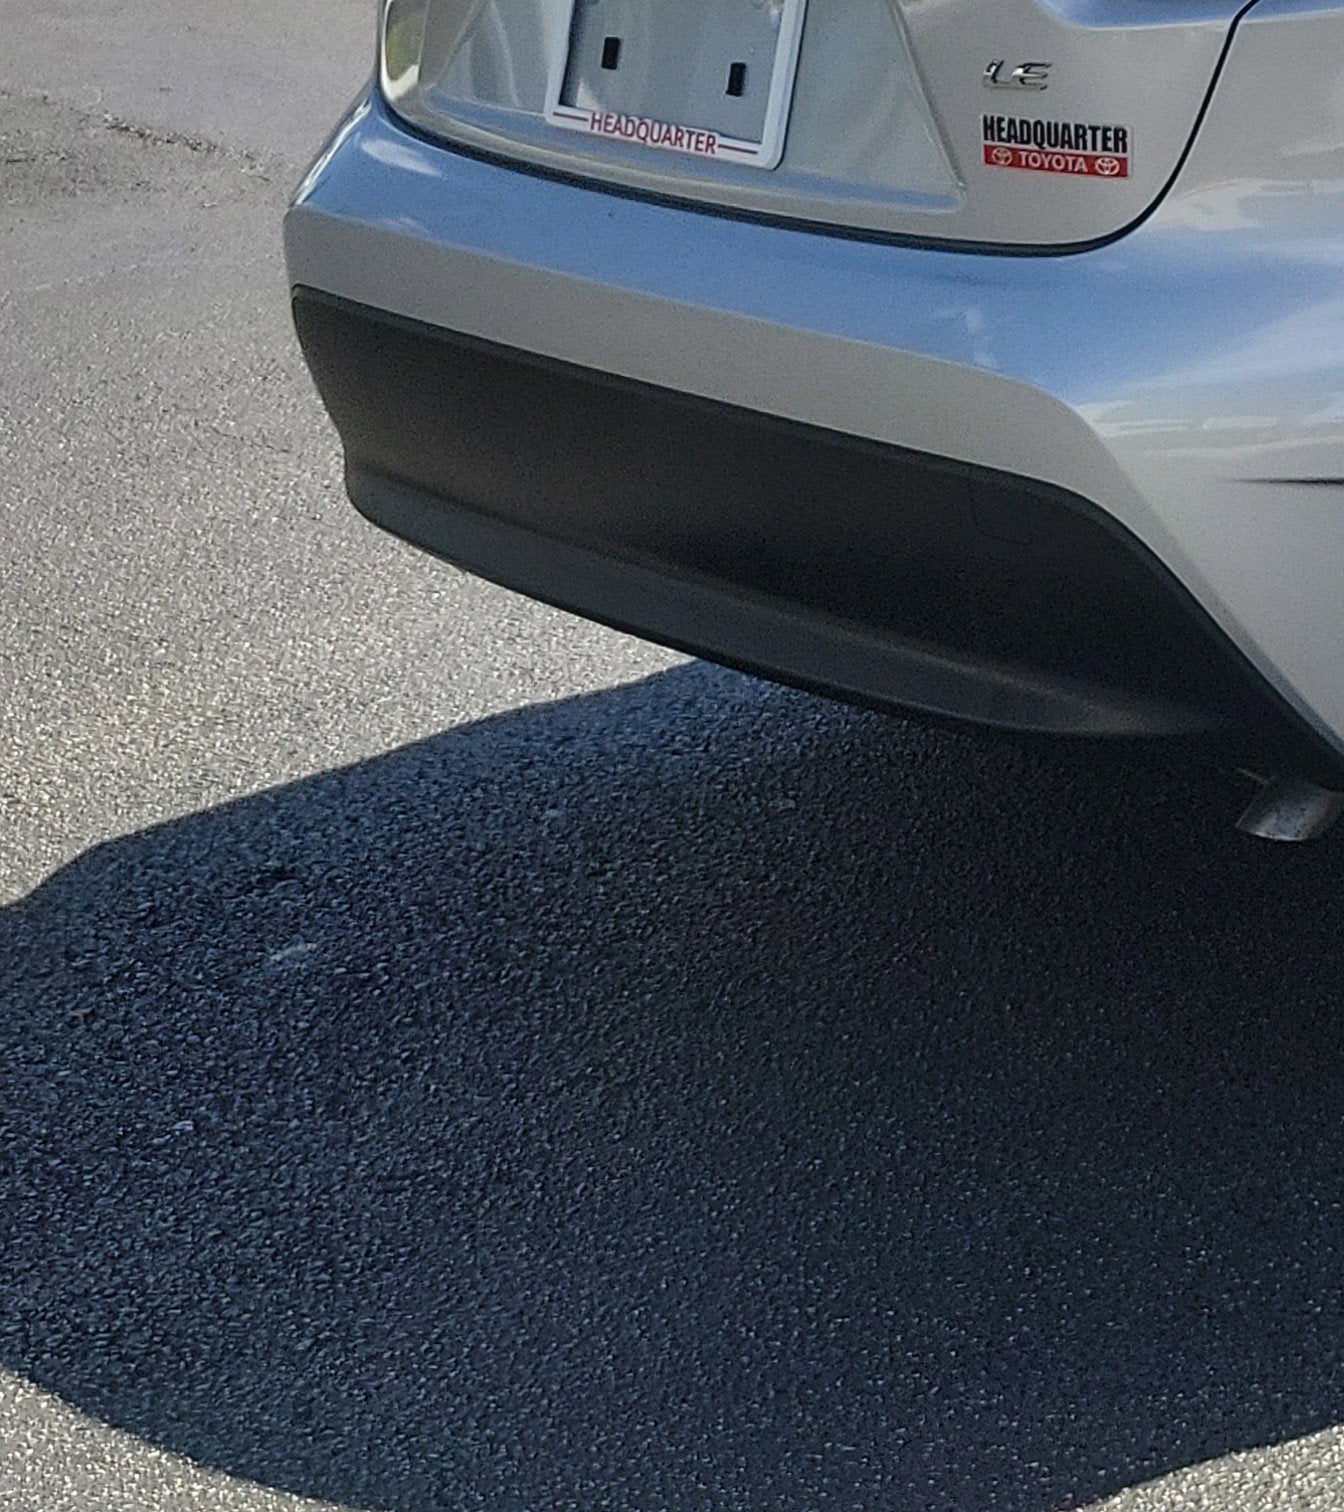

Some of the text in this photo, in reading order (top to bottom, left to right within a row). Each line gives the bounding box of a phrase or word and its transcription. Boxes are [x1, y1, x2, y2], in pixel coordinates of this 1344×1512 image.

[982, 59, 1053, 91] LE
[590, 112, 716, 155] HEADQUARTER
[982, 114, 1129, 154] HEADQUARTER
[1018, 150, 1089, 173] TOYOTA
